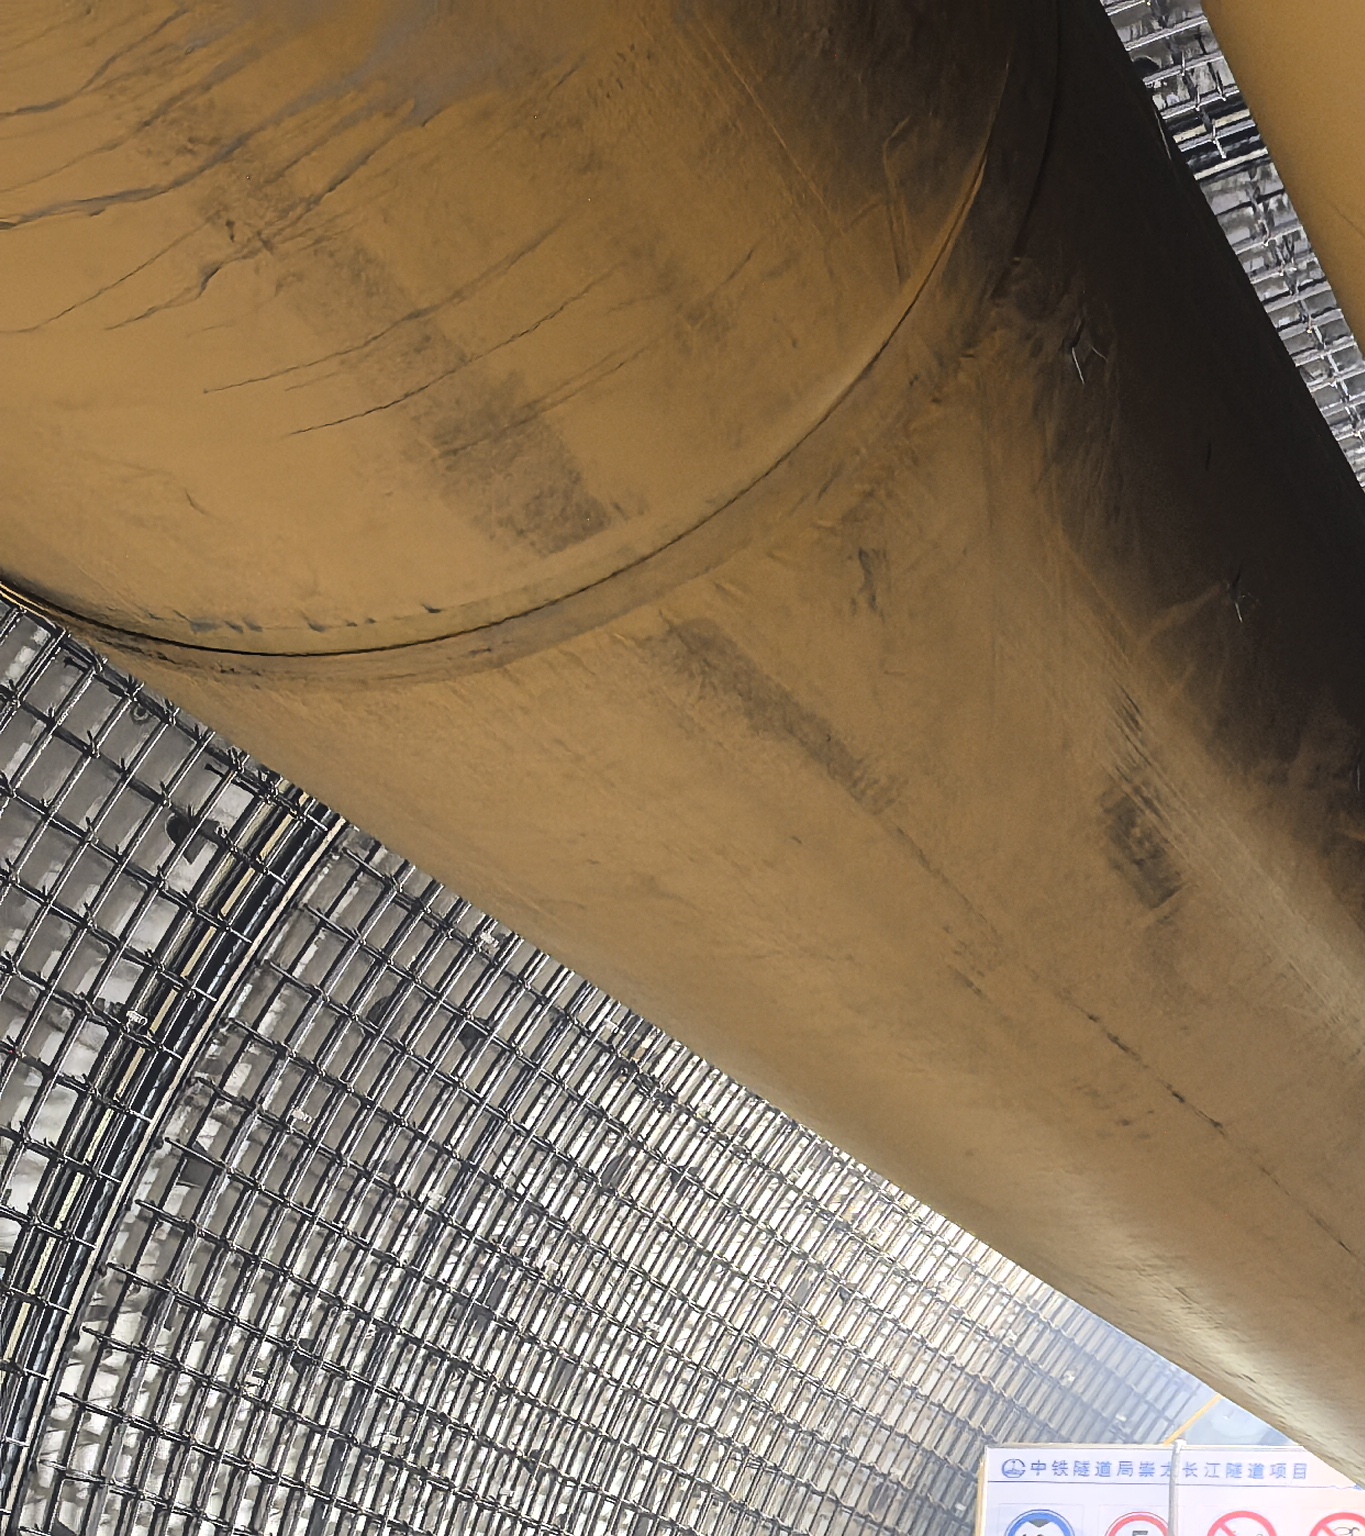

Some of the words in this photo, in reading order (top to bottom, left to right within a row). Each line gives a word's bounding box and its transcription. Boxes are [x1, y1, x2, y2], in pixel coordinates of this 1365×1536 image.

[1030, 1460, 1308, 1480] 中铁隧道局崇太长江隧道项目
